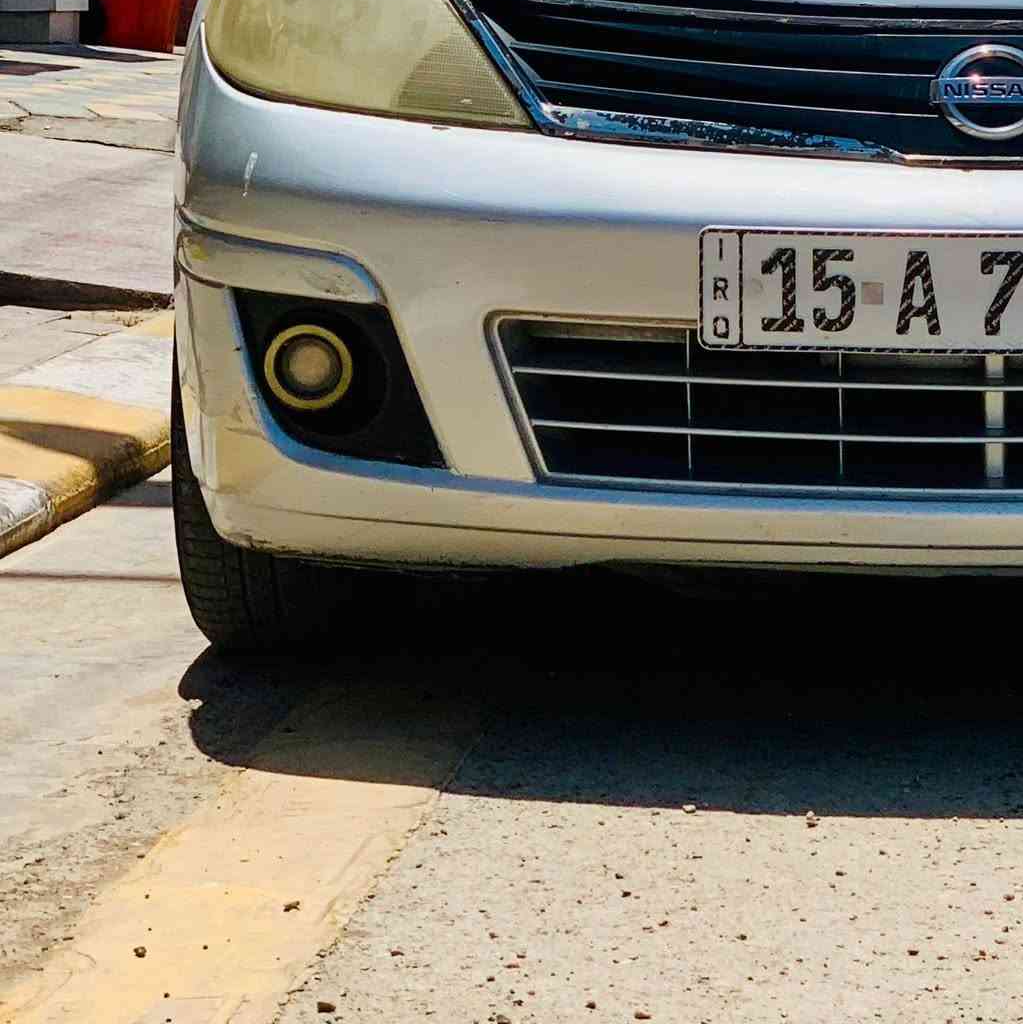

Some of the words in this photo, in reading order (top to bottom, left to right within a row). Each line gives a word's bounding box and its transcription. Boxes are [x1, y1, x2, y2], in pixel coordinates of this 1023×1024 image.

[713, 238, 729, 338] IRQ
[761, 248, 856, 332] 15
[895, 250, 942, 336] A
